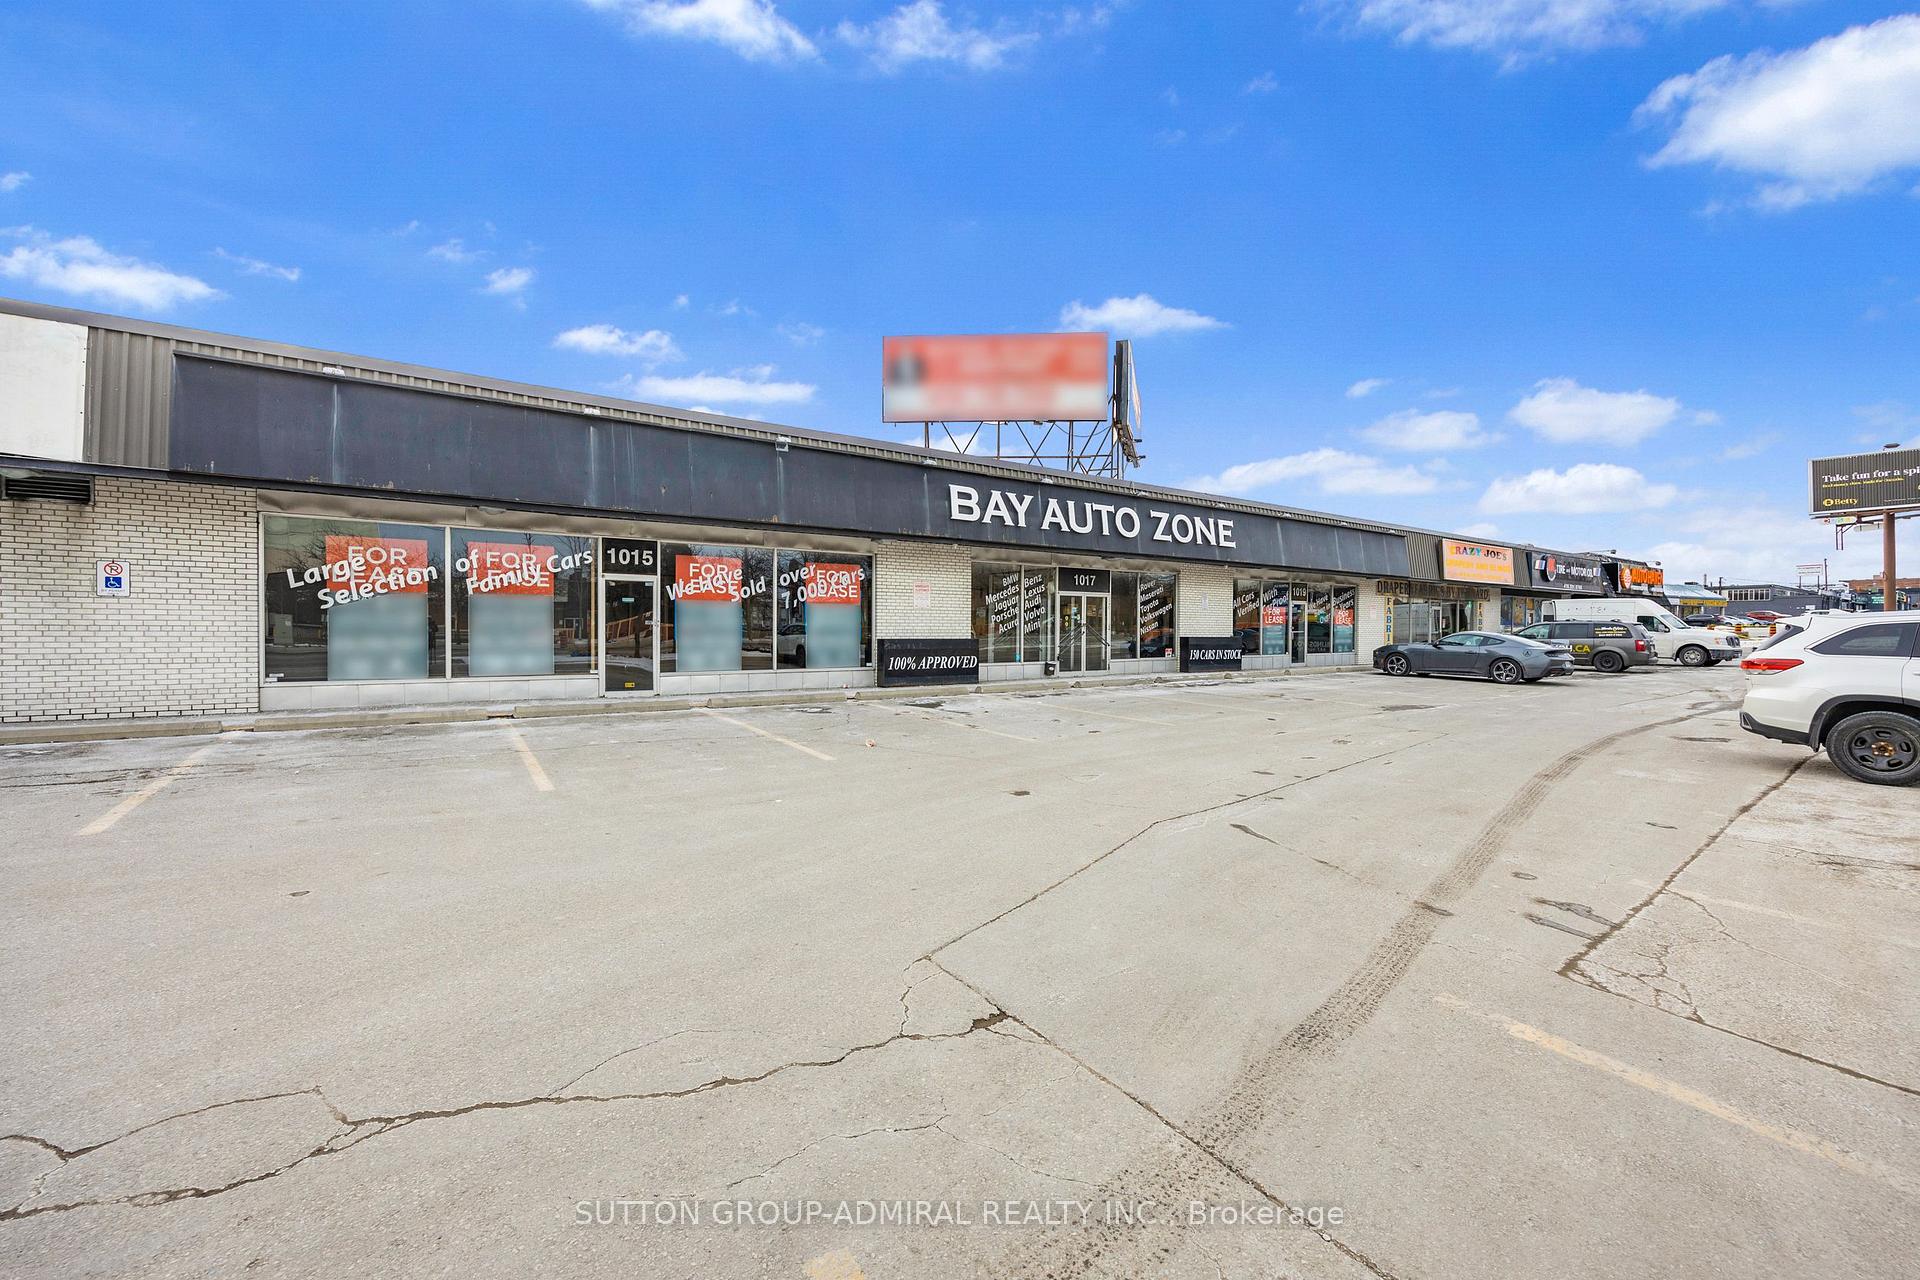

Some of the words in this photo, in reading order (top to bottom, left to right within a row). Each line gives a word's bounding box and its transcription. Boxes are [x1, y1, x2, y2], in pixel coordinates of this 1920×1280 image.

[1822, 473, 1849, 482] Take
[1852, 471, 1870, 480] fun
[1873, 470, 1890, 478] for
[1903, 466, 1920, 477] spi
[1834, 498, 1858, 506] Betty
[948, 484, 1034, 527] BAY
[1041, 498, 1141, 538] AUTO
[1150, 509, 1237, 548] ZONE
[348, 545, 407, 565] FOR
[607, 548, 654, 566] 1015
[1450, 545, 1481, 557] CRAZY
[455, 549, 479, 572] of
[486, 552, 537, 568] FOR
[286, 555, 367, 588] Large
[465, 562, 541, 595] Family
[546, 550, 594, 573] Cars
[689, 563, 728, 579] FOR
[780, 564, 816, 586] over
[1556, 564, 1566, 574] TIRE
[1571, 566, 1586, 576] MOTOR
[317, 564, 438, 609] Selection
[665, 580, 694, 601] We
[699, 568, 743, 592] have
[1002, 573, 1019, 586] BMW
[1024, 574, 1042, 588] Benz
[1073, 574, 1096, 586] 1017
[731, 575, 767, 602] Sold
[781, 579, 827, 609] 7,000
[809, 585, 858, 598] EASE
[985, 584, 1019, 605] Mercedes
[1024, 584, 1045, 599] Lexus
[1140, 584, 1164, 603] Maserati
[1262, 587, 1278, 603] With
[1292, 587, 1307, 597] 1019
[994, 595, 1019, 612] Jaguar
[1024, 594, 1041, 610] Audi
[1140, 599, 1159, 614] Toyota
[1233, 596, 1241, 610] All
[1242, 591, 1255, 604] Cars
[1237, 598, 1260, 617] Verified
[991, 606, 1019, 624] Porsche
[1024, 606, 1046, 621] Volvo
[1140, 603, 1172, 624] Volkswagen
[1265, 616, 1284, 624] LEASE
[1268, 608, 1280, 616] FOR
[999, 618, 1019, 634] Acura
[1024, 618, 1041, 634] Mini
[1140, 621, 1159, 635] Nissan
[888, 656, 916, 670] 100%
[918, 655, 978, 669] APPROVED
[1190, 650, 1200, 660] 150
[1200, 650, 1216, 660] CARS
[1216, 650, 1224, 660] IN
[1224, 649, 1242, 660] STOCK
